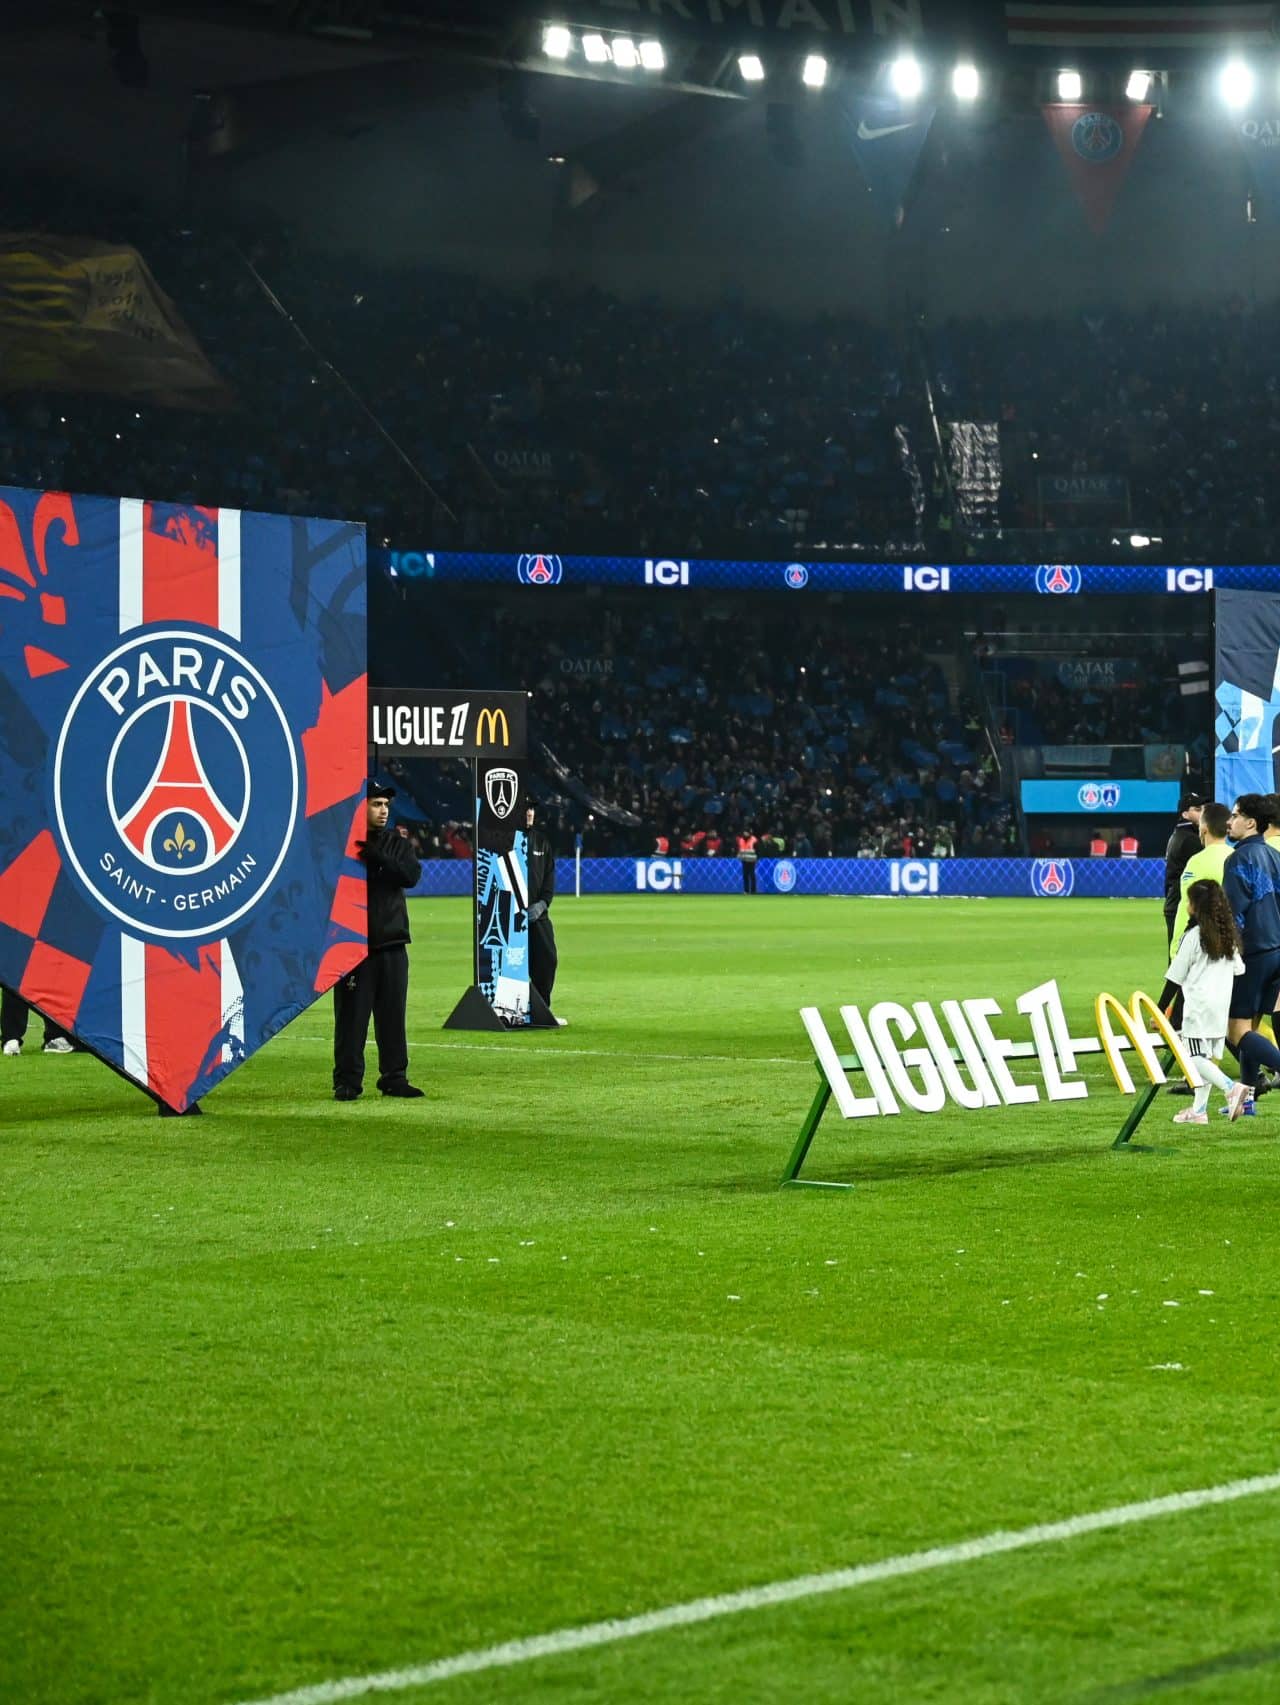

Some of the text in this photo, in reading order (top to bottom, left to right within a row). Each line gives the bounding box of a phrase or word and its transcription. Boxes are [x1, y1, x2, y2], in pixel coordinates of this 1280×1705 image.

[644, 560, 689, 585] ICI
[903, 566, 950, 591] ICI
[1166, 568, 1214, 592] ICI
[560, 658, 615, 674] QATAR
[98, 647, 257, 721] PARIS
[373, 705, 445, 745] LIGUE
[98, 851, 155, 906] SAINT
[173, 852, 257, 911] GERMAIN
[636, 861, 682, 889] ICI
[890, 862, 938, 892] ICI
[800, 997, 1040, 1119] LIGUE
